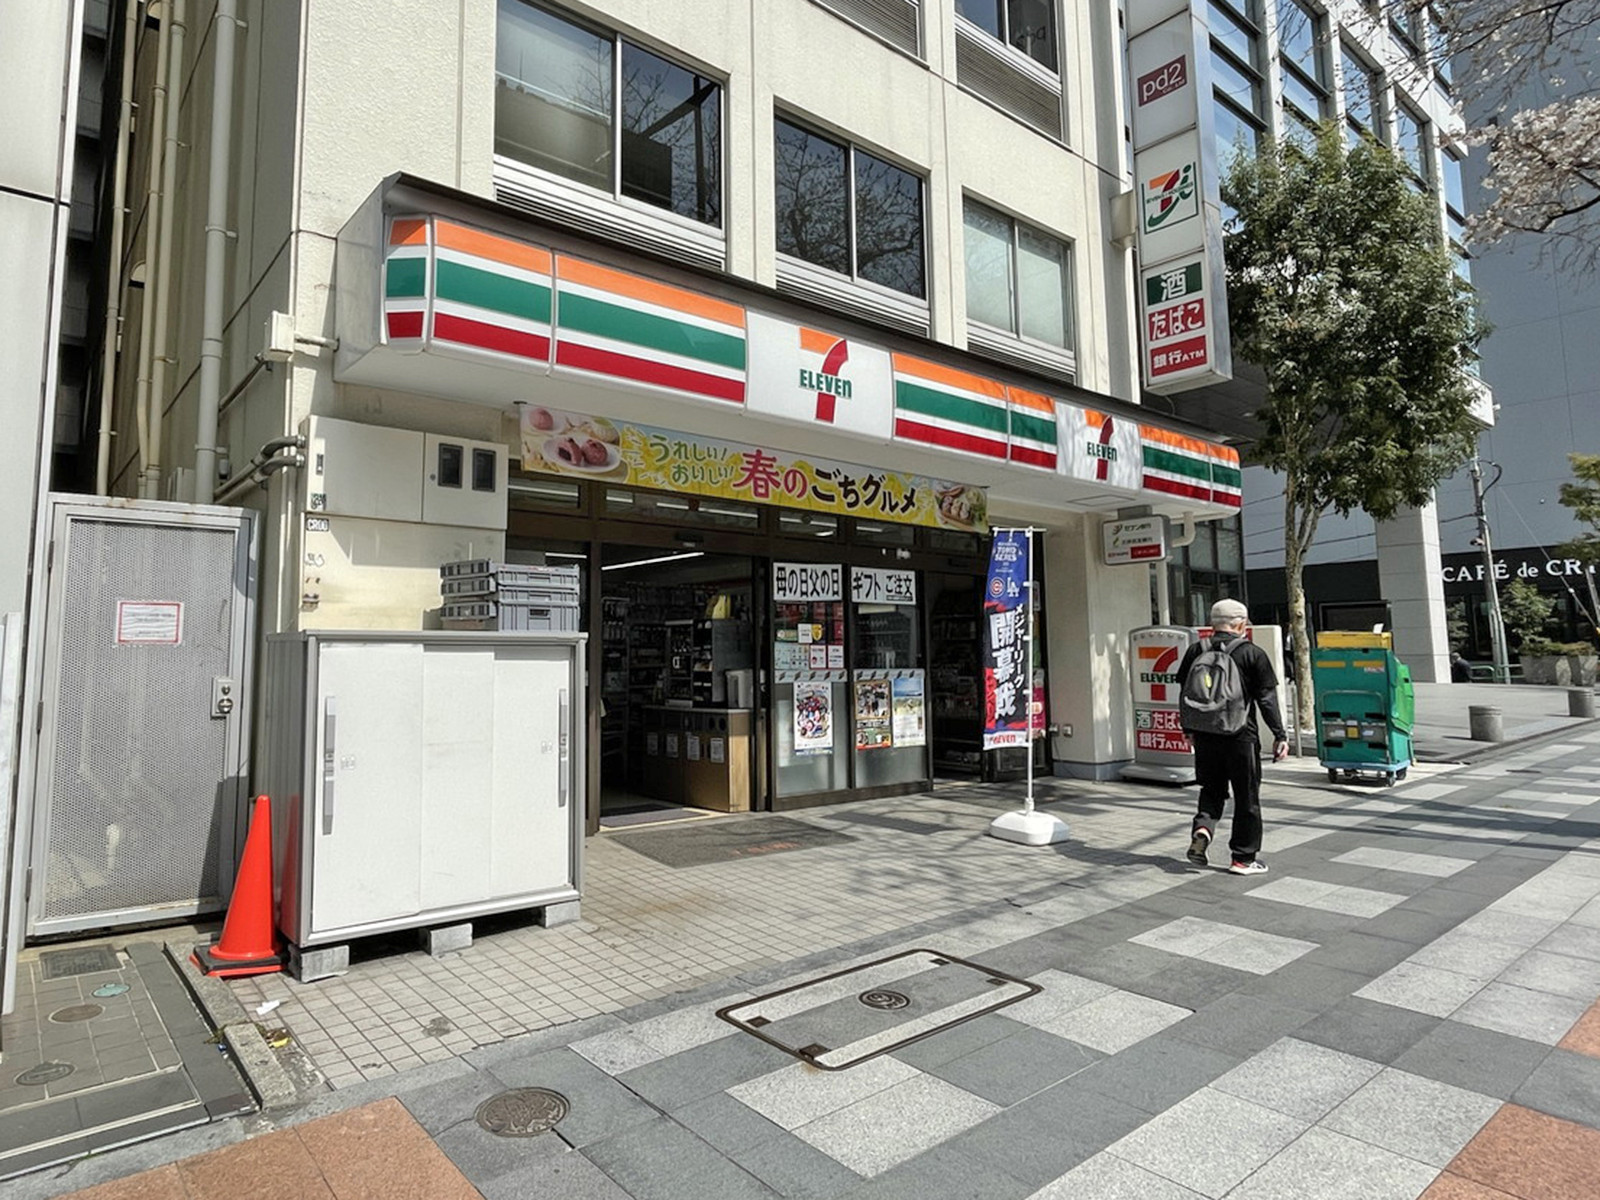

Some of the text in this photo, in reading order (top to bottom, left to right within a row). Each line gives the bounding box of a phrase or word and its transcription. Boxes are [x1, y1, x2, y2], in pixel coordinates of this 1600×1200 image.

[1143, 63, 1182, 102] pd2
[1161, 268, 1187, 301] 酒
[1151, 303, 1202, 340] たばこ
[799, 327, 849, 424] 7
[1153, 350, 1204, 368] 銀行ATM
[732, 448, 917, 514] 春のごちグルメ
[776, 566, 840, 598] 母の日父の日
[853, 572, 913, 600] ギフト ご注文
[1517, 562, 1539, 577] de
[1014, 603, 1025, 689] メジャーリーグ
[990, 610, 1016, 719] 開幕戦
[1136, 711, 1151, 729] 酒
[1139, 732, 1189, 751] 銀行ATM
